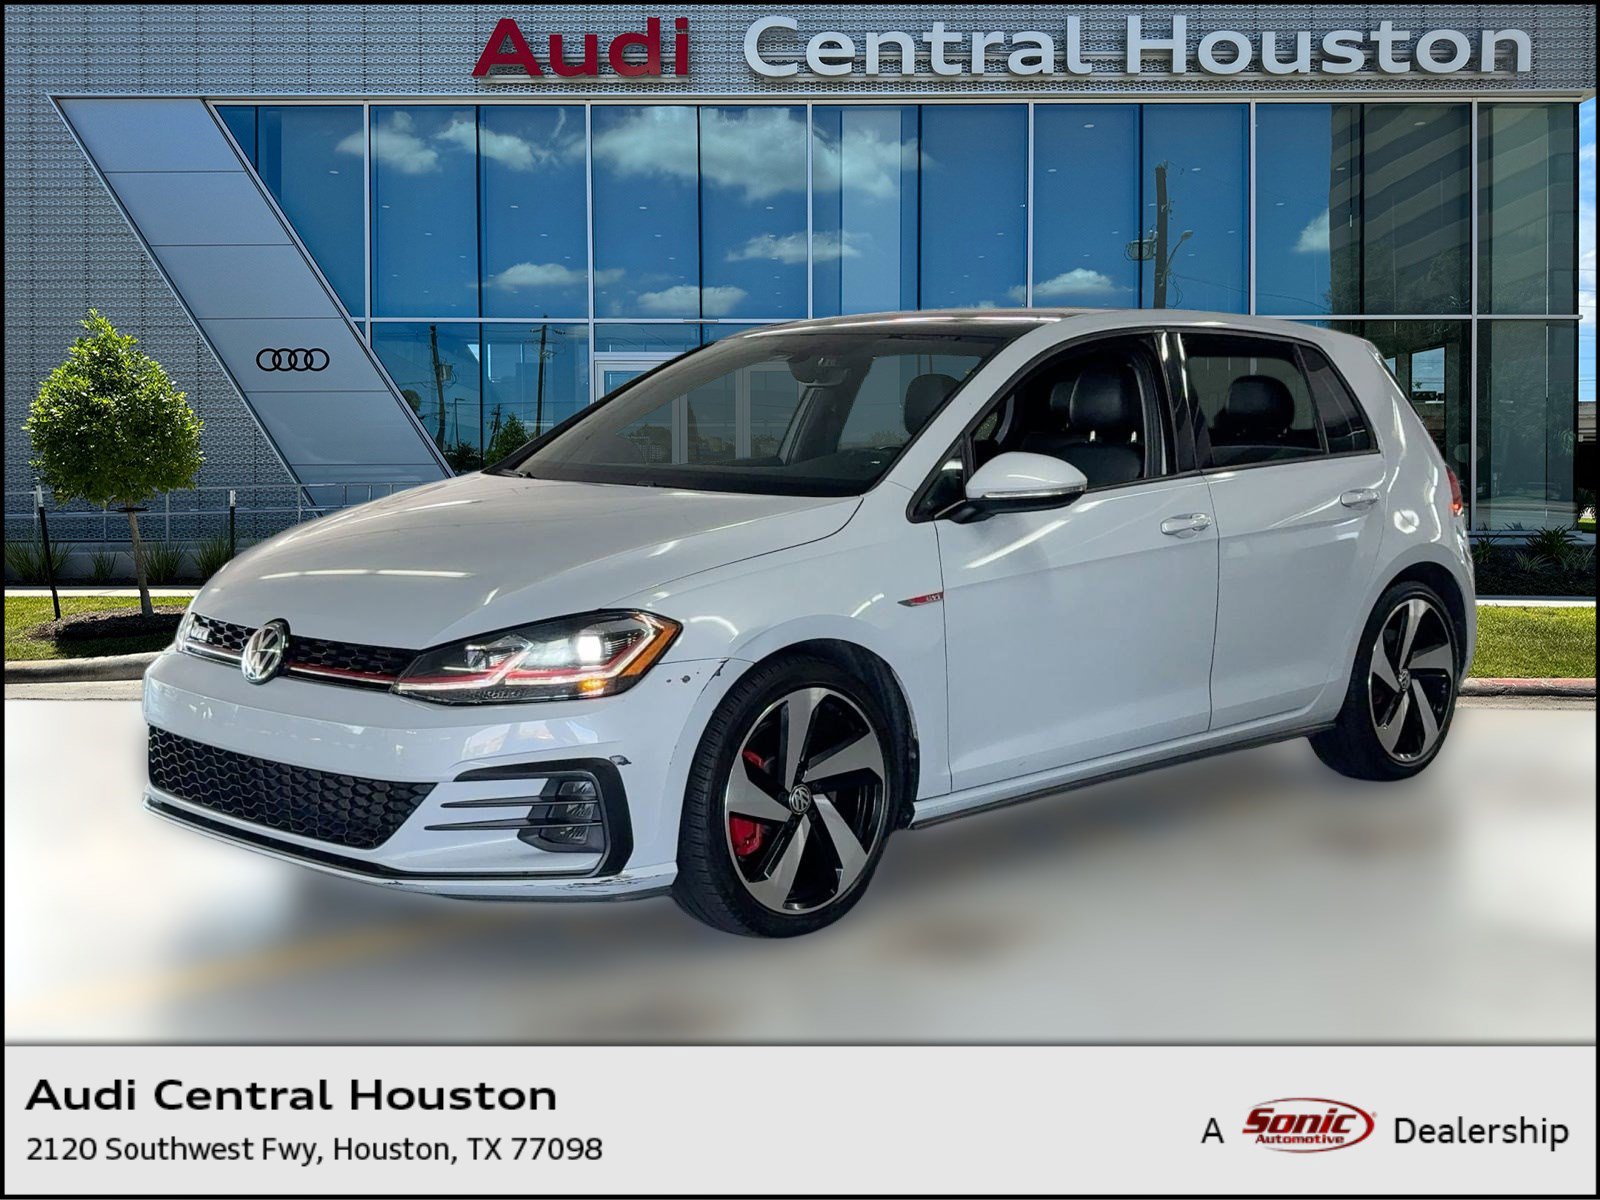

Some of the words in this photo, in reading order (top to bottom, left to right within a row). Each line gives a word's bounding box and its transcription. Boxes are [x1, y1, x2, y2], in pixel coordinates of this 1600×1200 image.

[473, 17, 689, 77] Audi
[743, 15, 1093, 77] Central
[1126, 15, 1531, 75] Houston
